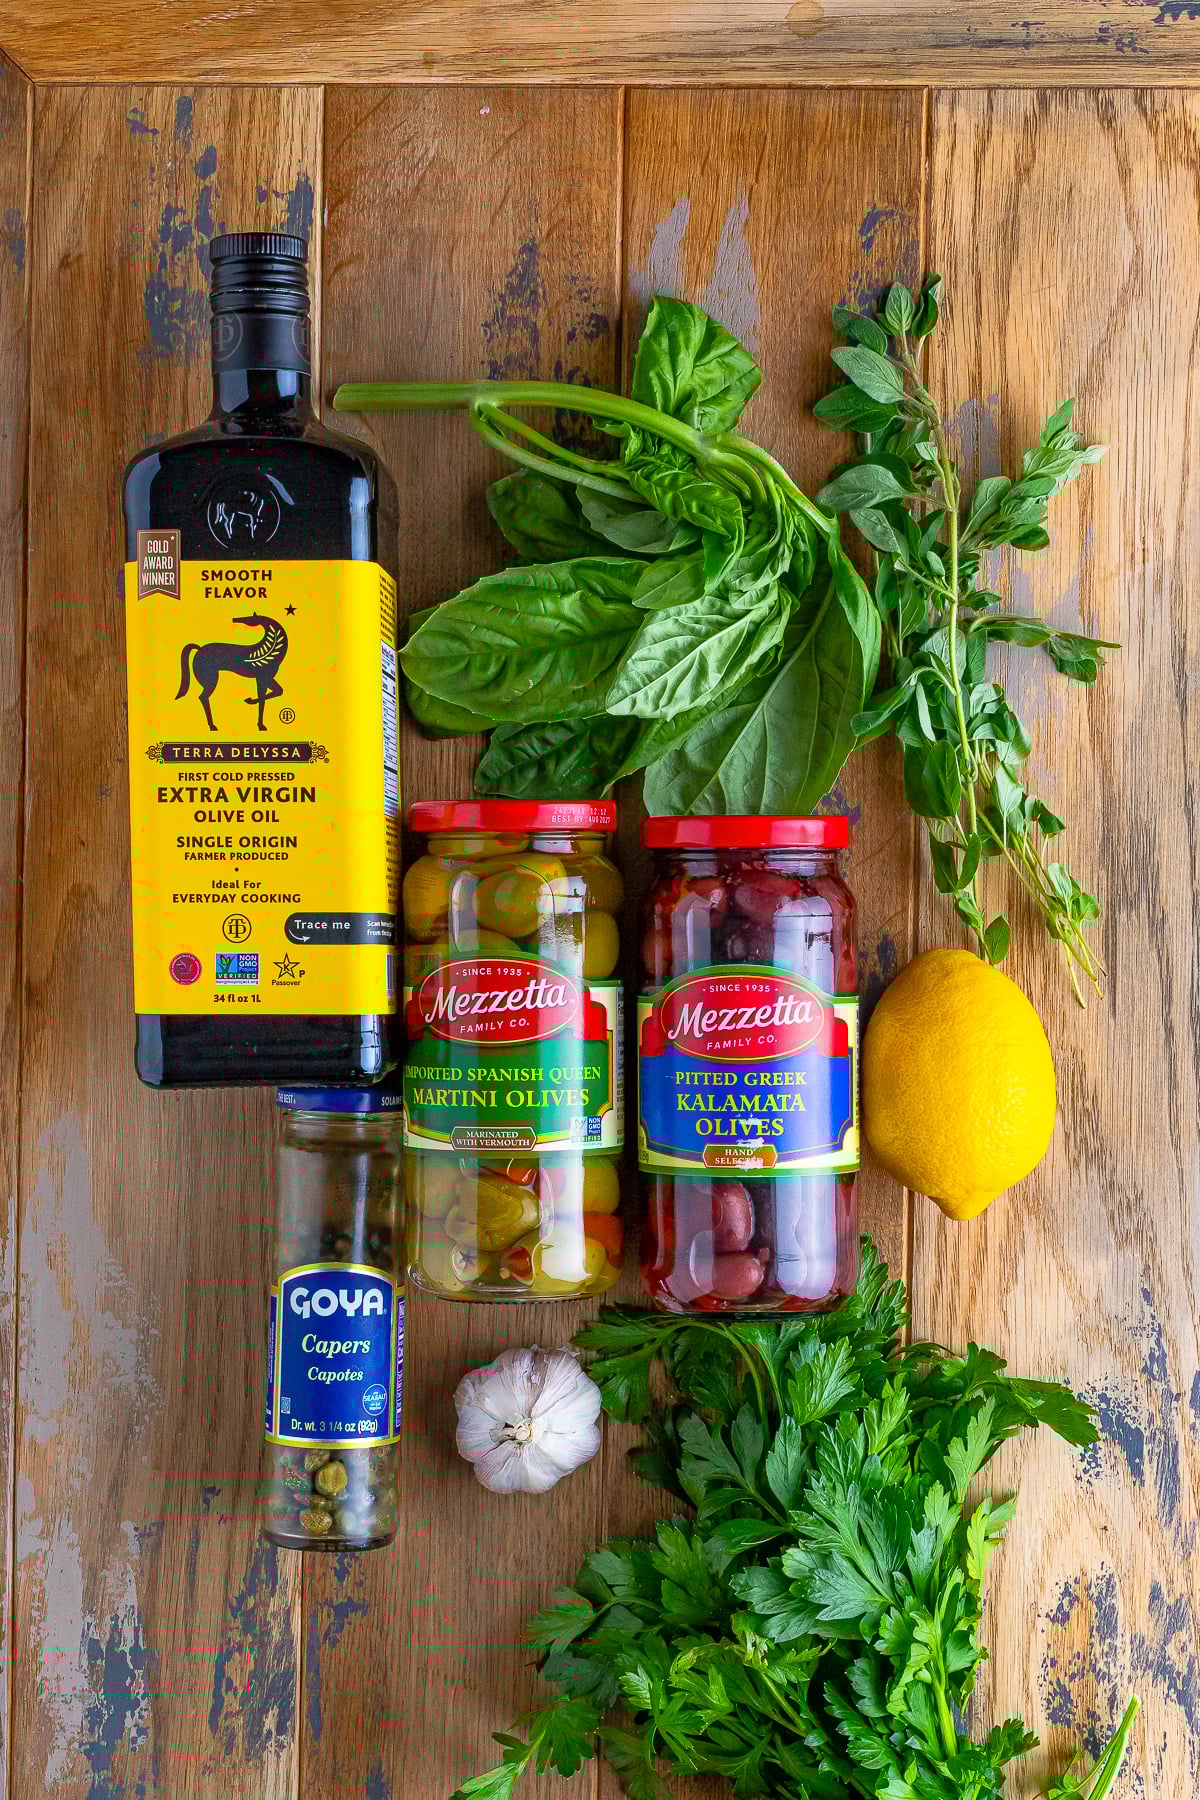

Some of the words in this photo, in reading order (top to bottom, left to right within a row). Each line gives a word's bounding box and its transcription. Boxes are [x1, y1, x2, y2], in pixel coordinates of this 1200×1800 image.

[147, 540, 169, 554] GOLD
[143, 557, 174, 570] AWARD
[142, 573, 175, 586] WINNER
[201, 570, 273, 582] SMOOTH
[205, 587, 268, 599] FLAVOR
[172, 748, 224, 758] TERRA
[231, 748, 301, 758] DELYSSA
[178, 772, 209, 782] FIRST
[212, 772, 244, 782] COLD
[247, 772, 295, 782] PRESSED
[157, 787, 230, 803] EXTRA
[236, 787, 316, 803] VIRGIN
[194, 810, 245, 823] OLIVE
[251, 810, 280, 823] OIL
[176, 836, 233, 848] SINGLE
[238, 836, 298, 848] ORIGIN
[184, 852, 227, 861] FARMER
[230, 852, 289, 861] PRODUCED
[211, 880, 240, 889] Ideal
[244, 880, 262, 889] For
[172, 894, 236, 904] EVERYDAY
[241, 894, 301, 904] COOKING
[294, 920, 328, 930] Trace
[332, 921, 351, 930] me
[299, 970, 306, 978] P
[462, 968, 492, 976] SINCE
[497, 968, 522, 976] 1935
[709, 984, 740, 993] SINCE
[745, 984, 770, 992] 1935
[213, 995, 226, 1003] 34
[228, 994, 236, 1003] fl
[251, 995, 261, 1003] 1L
[425, 980, 568, 1023] Mezzetta
[667, 994, 814, 1040] Mezzetta
[460, 1021, 504, 1034] FAMILY
[510, 1018, 530, 1028] CO.
[706, 1038, 752, 1050] FAMILY
[758, 1035, 778, 1044] CO.
[405, 1065, 463, 1081] IMPORTED
[467, 1067, 544, 1082] SPANISH
[549, 1066, 601, 1084] QUEEN
[675, 1071, 738, 1086] PITTED
[743, 1071, 807, 1086] GREEK
[413, 1087, 497, 1108] MARTINI
[505, 1088, 590, 1108] OLIVES
[676, 1093, 806, 1112] KALAMATA
[695, 1118, 785, 1137] OLIVES
[456, 1138, 477, 1146] WITH
[290, 1287, 384, 1319] GOYA
[301, 1333, 371, 1359] Capers
[307, 1367, 364, 1384] Capotes
[291, 1418, 303, 1431] Dr.
[304, 1421, 317, 1432] wt.
[319, 1421, 326, 1432] 3
[328, 1421, 343, 1432] 1/4
[344, 1422, 356, 1432] oz
[357, 1419, 378, 1434] (92g)
